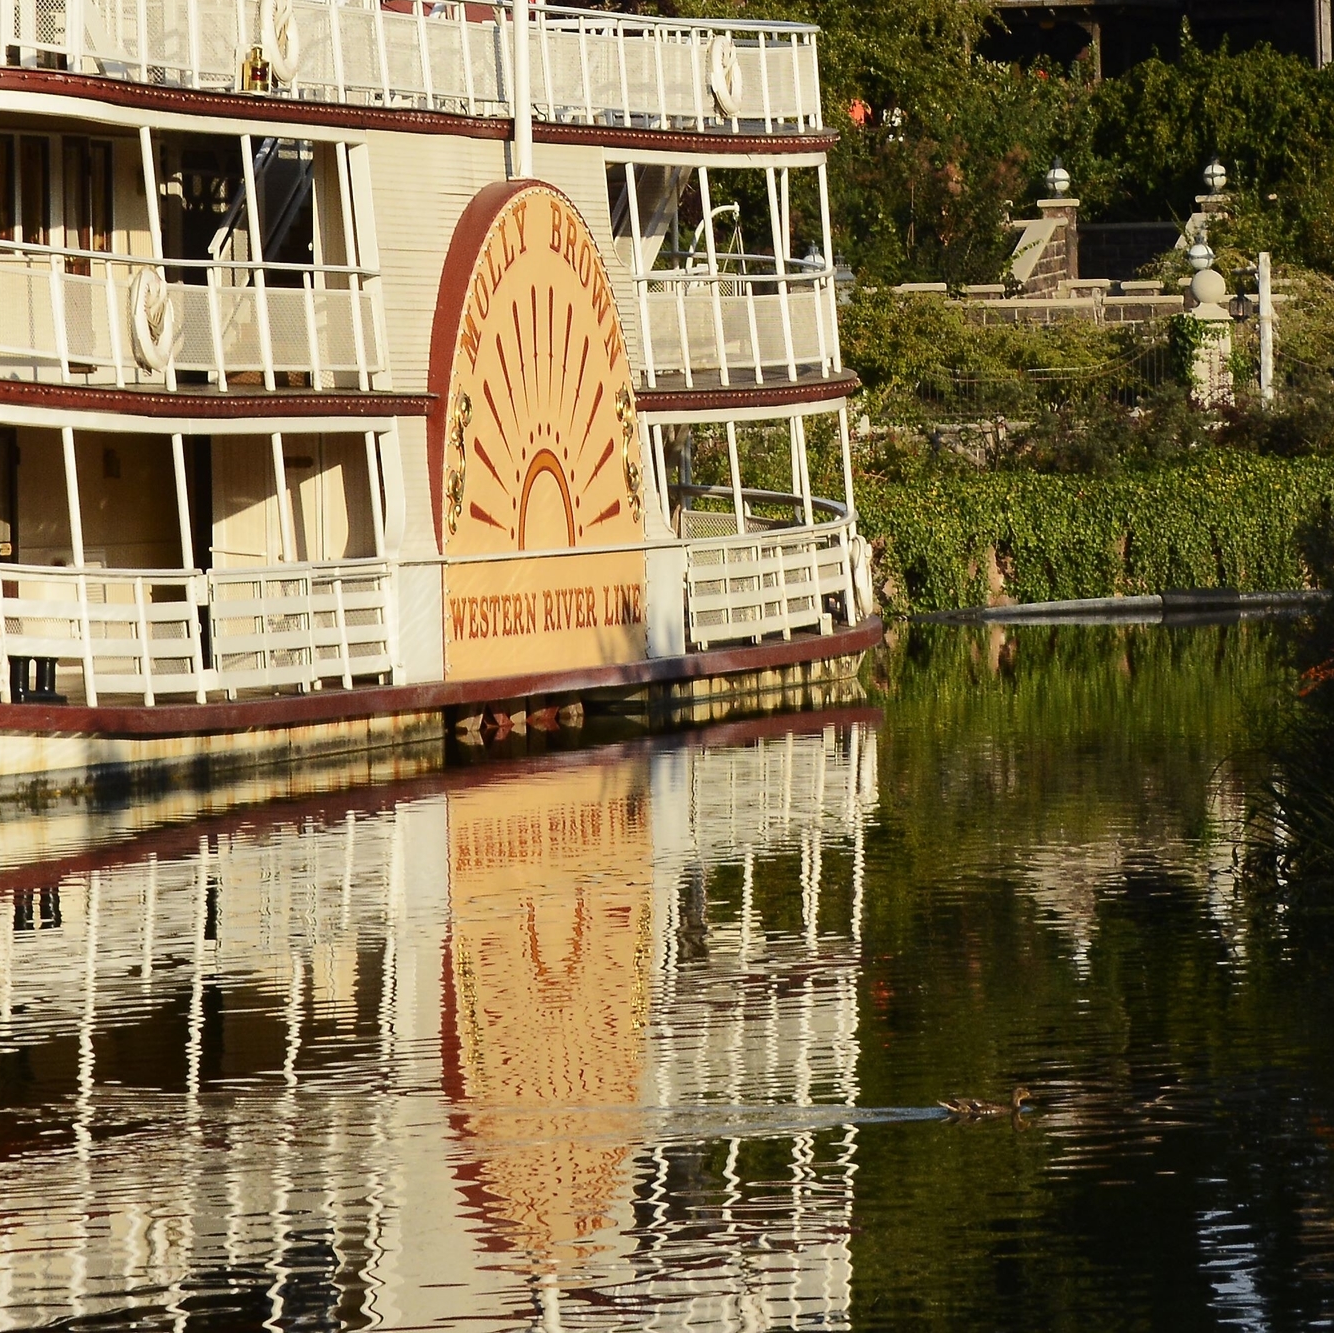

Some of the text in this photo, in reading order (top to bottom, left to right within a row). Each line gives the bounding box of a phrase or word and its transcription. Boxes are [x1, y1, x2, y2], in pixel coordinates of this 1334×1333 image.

[460, 200, 622, 374] MOLLY BROWN
[450, 583, 642, 641] WESTERN RIVER LINE
